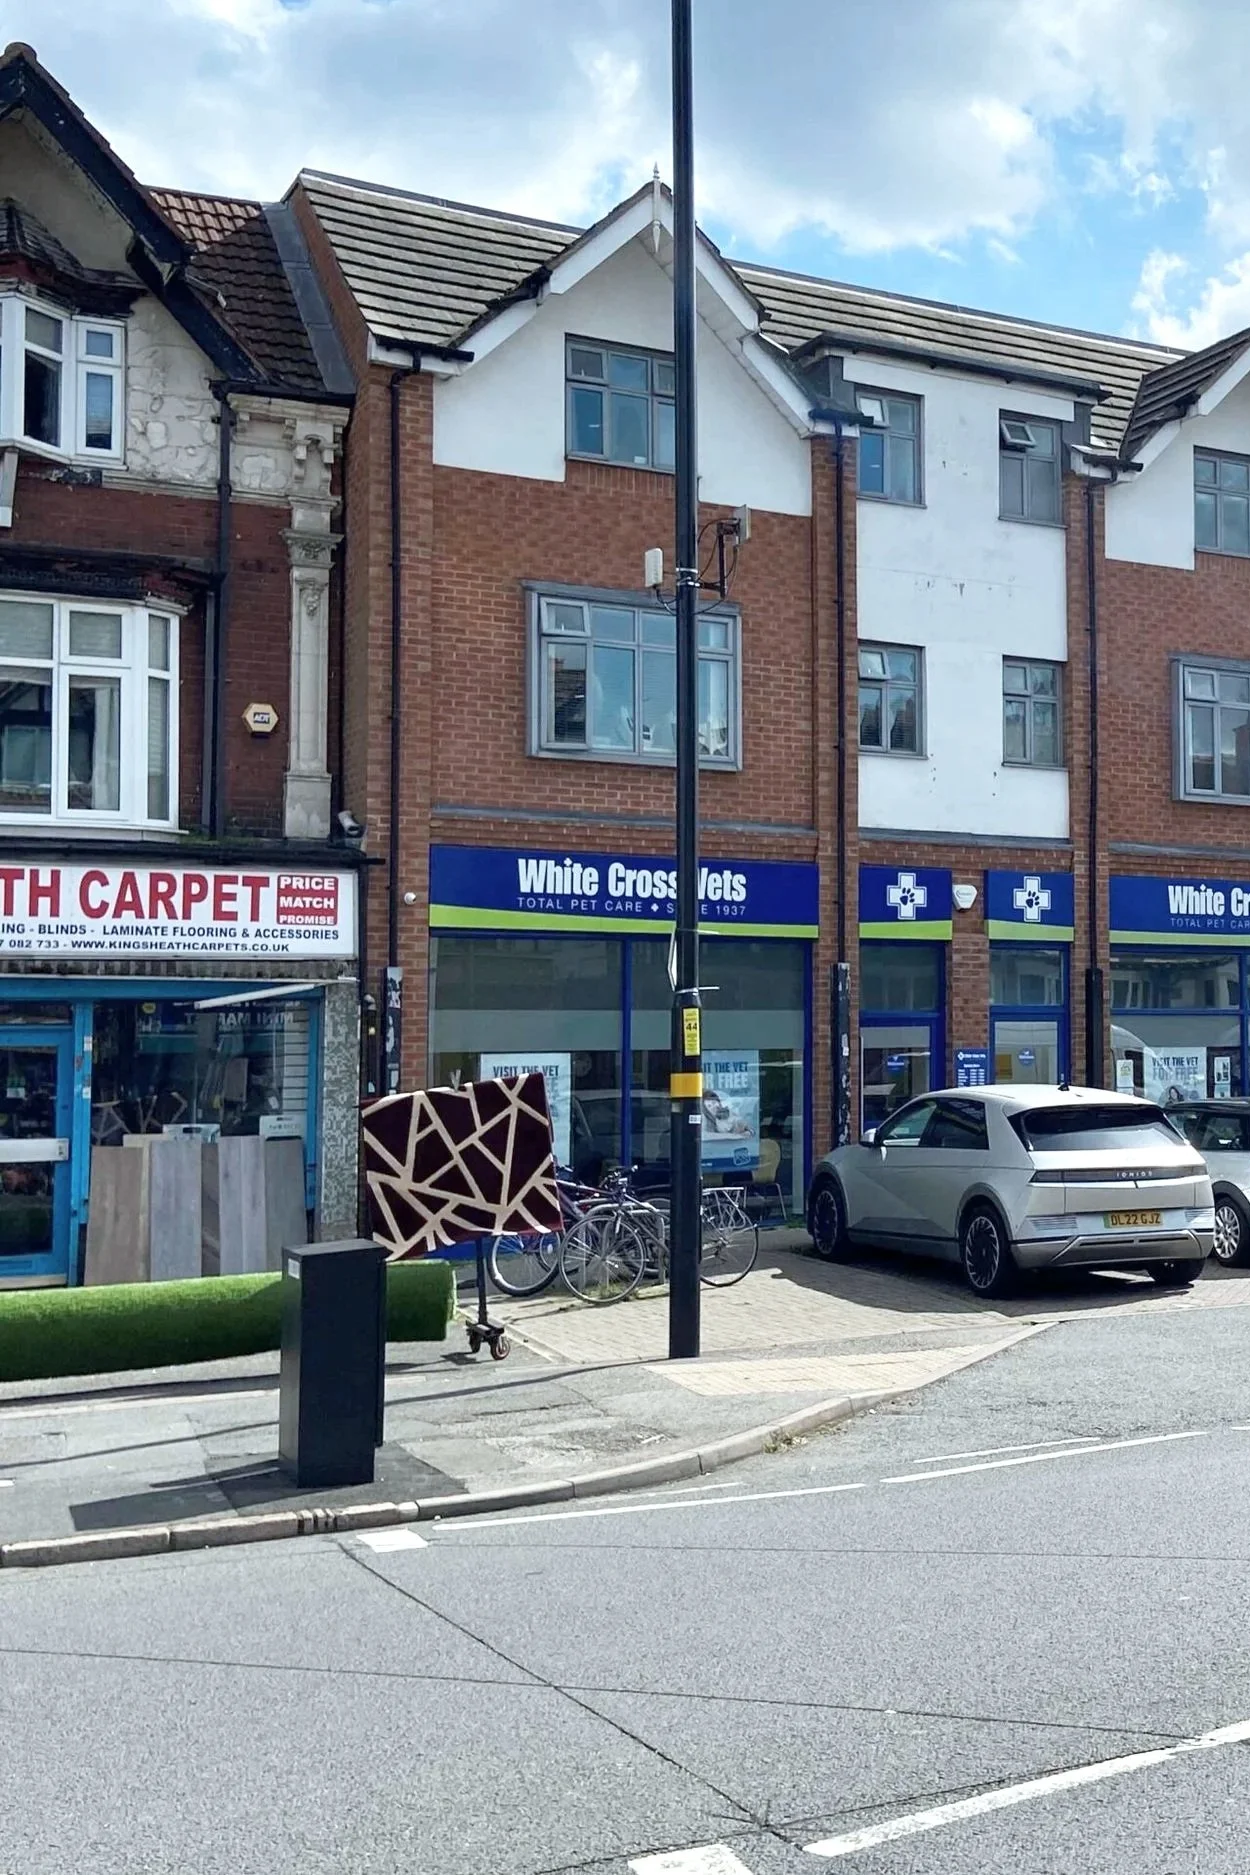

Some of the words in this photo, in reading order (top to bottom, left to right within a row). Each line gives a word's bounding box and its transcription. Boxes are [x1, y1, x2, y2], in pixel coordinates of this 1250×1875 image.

[280, 876, 335, 890] PRICE
[518, 857, 599, 896] White
[607, 862, 677, 899] Cross
[79, 870, 270, 922] CARPET
[279, 896, 335, 909] MATCH
[1168, 884, 1225, 916] White
[518, 897, 563, 910] TOTAL
[571, 900, 597, 911] PET
[604, 901, 642, 913] CARE
[716, 905, 747, 916] 1937
[279, 915, 335, 925] PROMISE
[1171, 917, 1201, 928] TOTAL
[1207, 918, 1225, 929] PET
[38, 924, 87, 935] BLINDS
[103, 925, 168, 936] LAMINATE
[173, 926, 237, 938] FLOORING
[241, 928, 250, 938] &
[254, 928, 339, 939] ACCESSORIES
[9, 939, 32, 948] 082
[37, 940, 60, 949] 733
[71, 940, 290, 952] WWW.KINGSHEATHCARPETS.CO.UK
[493, 1065, 518, 1077] VISIT
[542, 1064, 559, 1077] VET
[714, 1062, 731, 1073] THE
[732, 1061, 748, 1072] VET
[718, 1073, 748, 1089] FREE
[1111, 1213, 1138, 1226] DL22
[1140, 1213, 1161, 1224] GJZ
